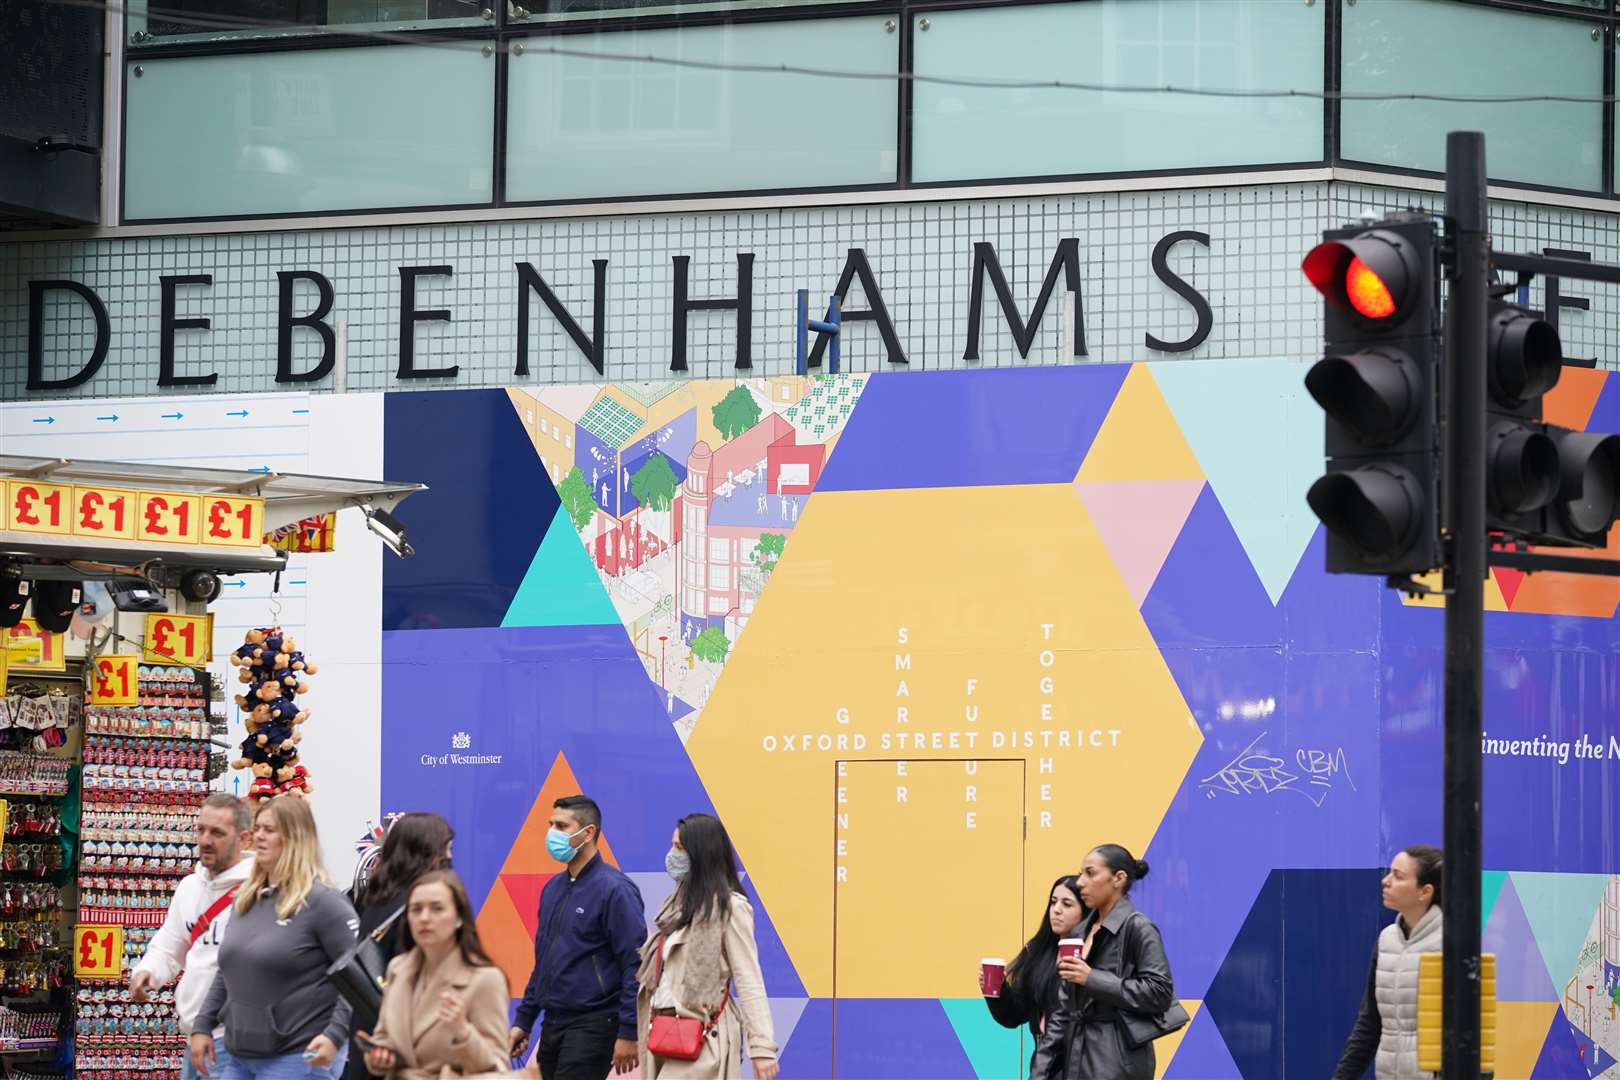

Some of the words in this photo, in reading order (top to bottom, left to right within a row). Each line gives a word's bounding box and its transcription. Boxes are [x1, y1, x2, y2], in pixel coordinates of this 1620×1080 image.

[26, 230, 1213, 391] DEBENHAMS
[15, 486, 60, 527] £1
[79, 491, 124, 532] £1
[144, 496, 189, 537] £1
[208, 500, 253, 540] £1
[152, 618, 195, 658] £1
[96, 660, 129, 698] £1
[896, 627, 911, 803] SMARTER
[1039, 623, 1055, 828] TOGETHER
[421, 753, 438, 767] City
[439, 753, 449, 765] of
[450, 753, 502, 765] Westminster
[762, 734, 868, 752] OXFORD
[880, 731, 978, 751] STREET
[992, 728, 1121, 749] DISTRICT
[964, 678, 979, 829] FUTURE
[1574, 733, 1604, 760] the
[835, 706, 850, 883] GREENER
[79, 926, 114, 969] £1
